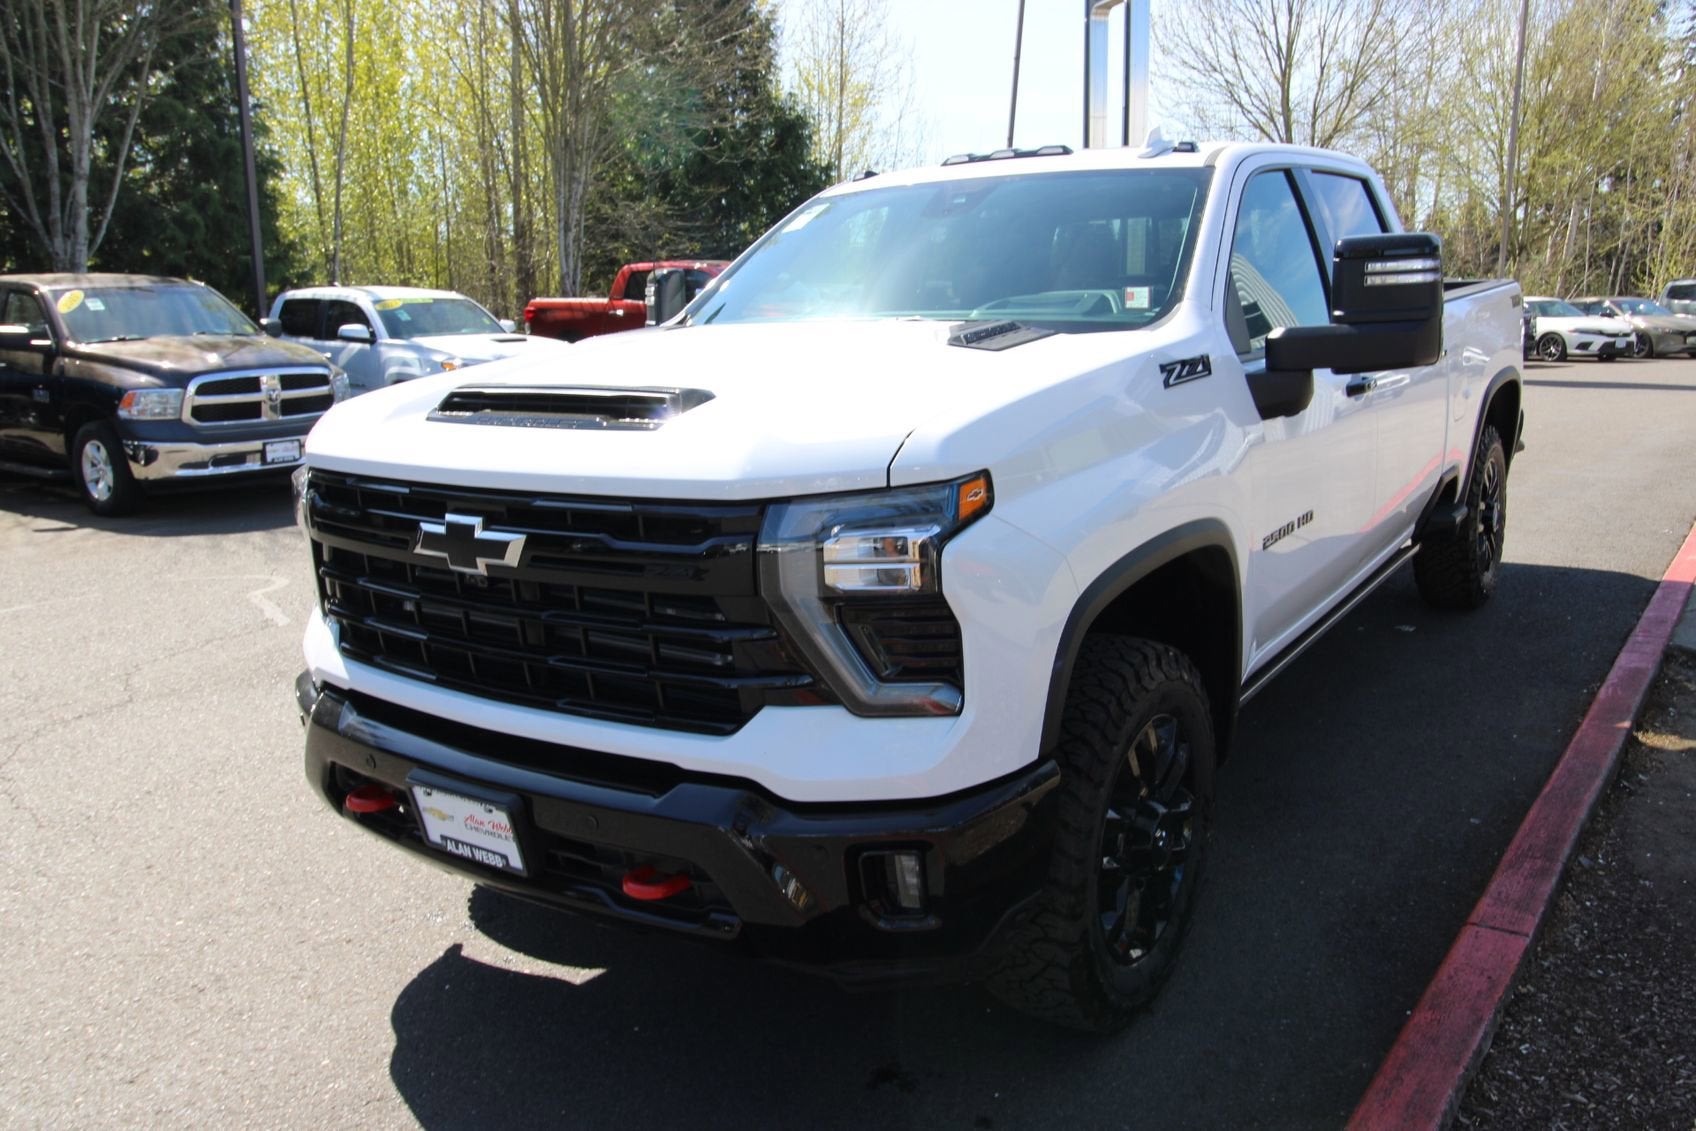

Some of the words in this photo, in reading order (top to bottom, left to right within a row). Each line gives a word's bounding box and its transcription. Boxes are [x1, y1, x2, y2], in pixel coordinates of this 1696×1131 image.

[1159, 353, 1212, 390] Z71
[1263, 520, 1295, 551] 2500
[1297, 509, 1314, 529] HD
[446, 840, 472, 858] ALAN
[472, 847, 504, 868] WEBB
